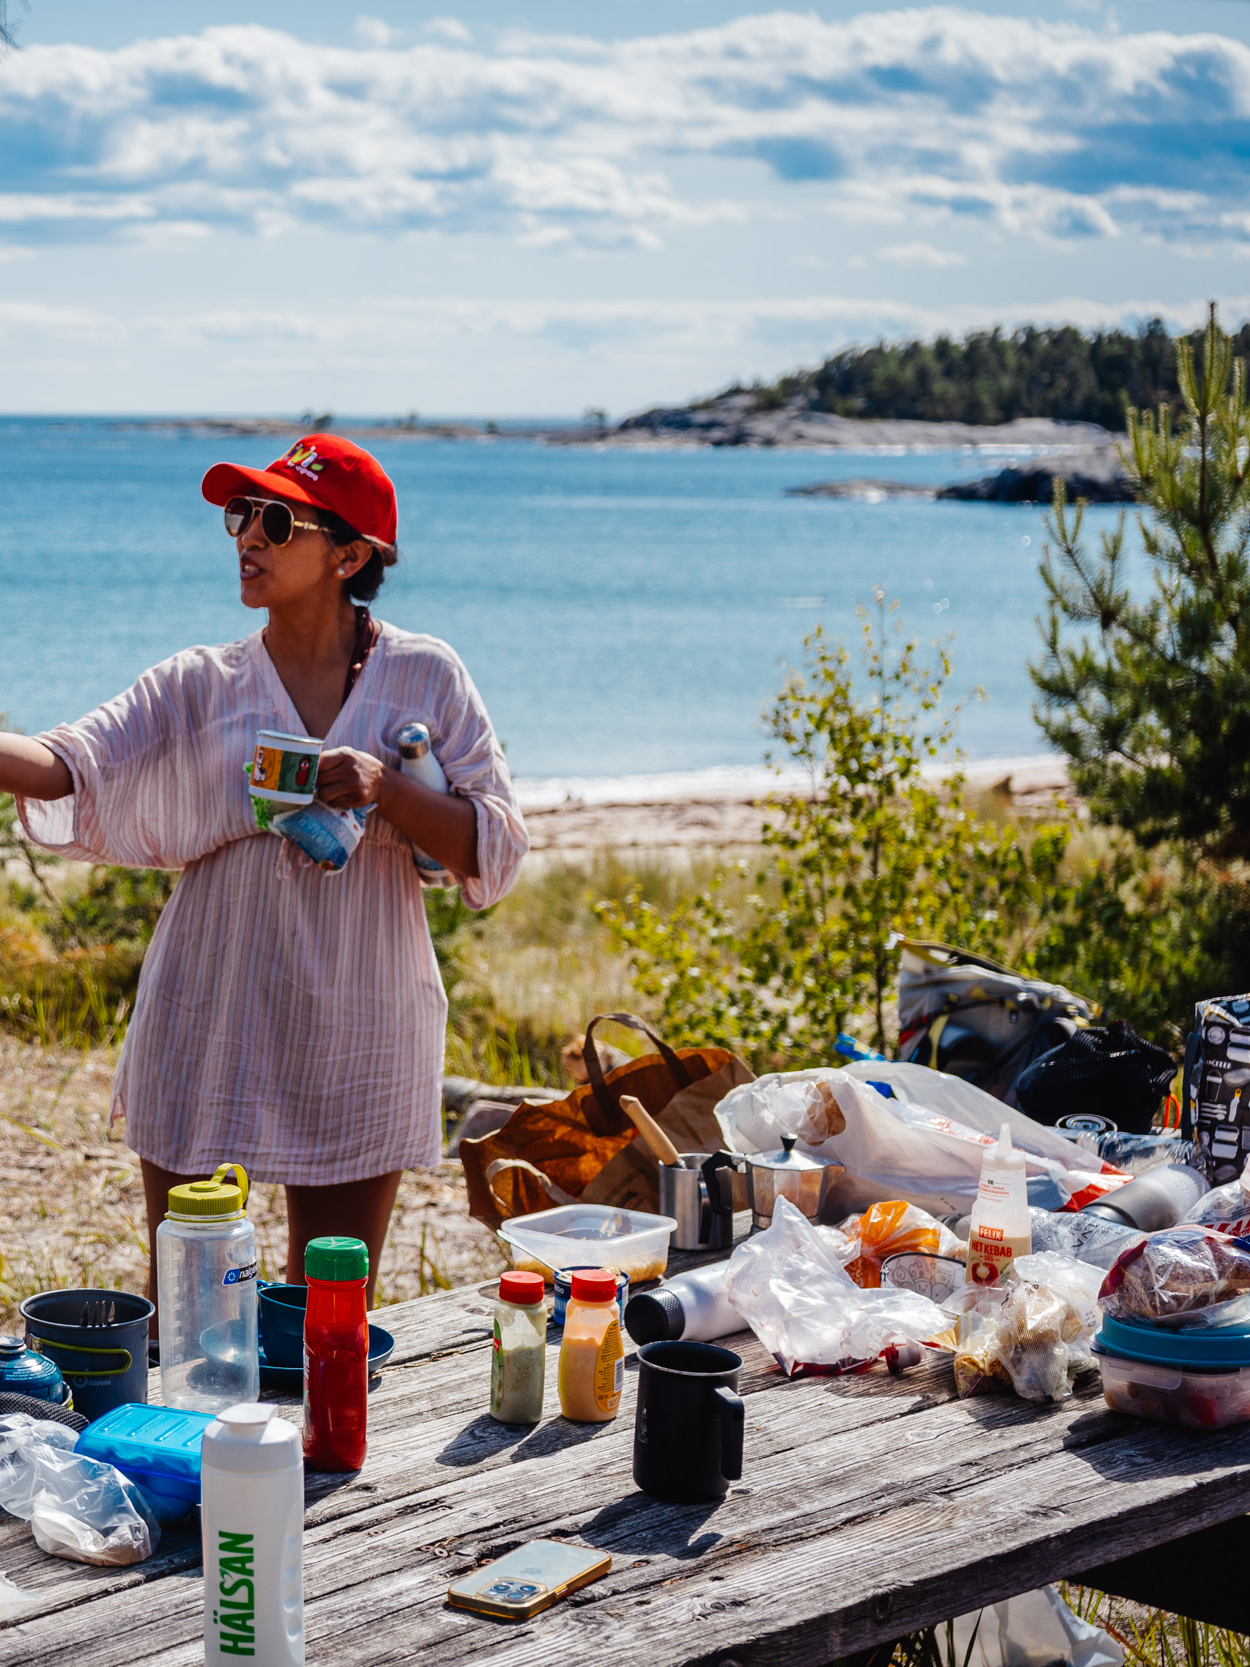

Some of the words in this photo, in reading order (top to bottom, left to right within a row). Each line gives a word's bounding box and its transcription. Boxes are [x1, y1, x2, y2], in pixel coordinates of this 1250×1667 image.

[979, 1227, 1003, 1240] FELIX
[971, 1240, 983, 1252] HET
[984, 1243, 1013, 1258] KEBAB
[213, 1530, 255, 1656] HÄLSAN
